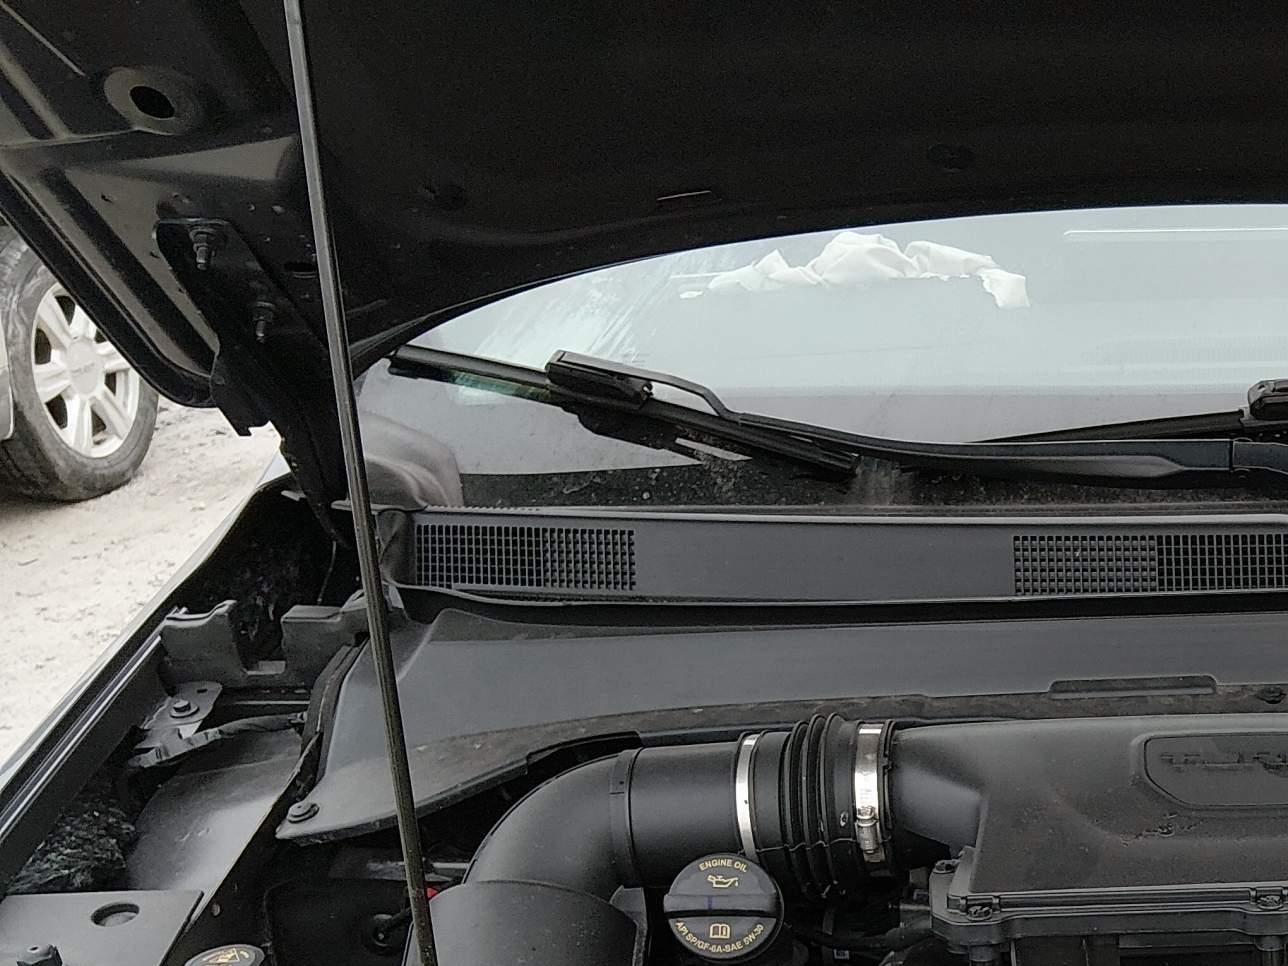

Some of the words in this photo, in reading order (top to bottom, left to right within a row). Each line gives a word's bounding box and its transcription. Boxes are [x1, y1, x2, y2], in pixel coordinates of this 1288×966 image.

[698, 859, 733, 872] ENGINE
[734, 860, 748, 873] OIL
[675, 921, 688, 937] API
[743, 924, 765, 945] 5W-30
